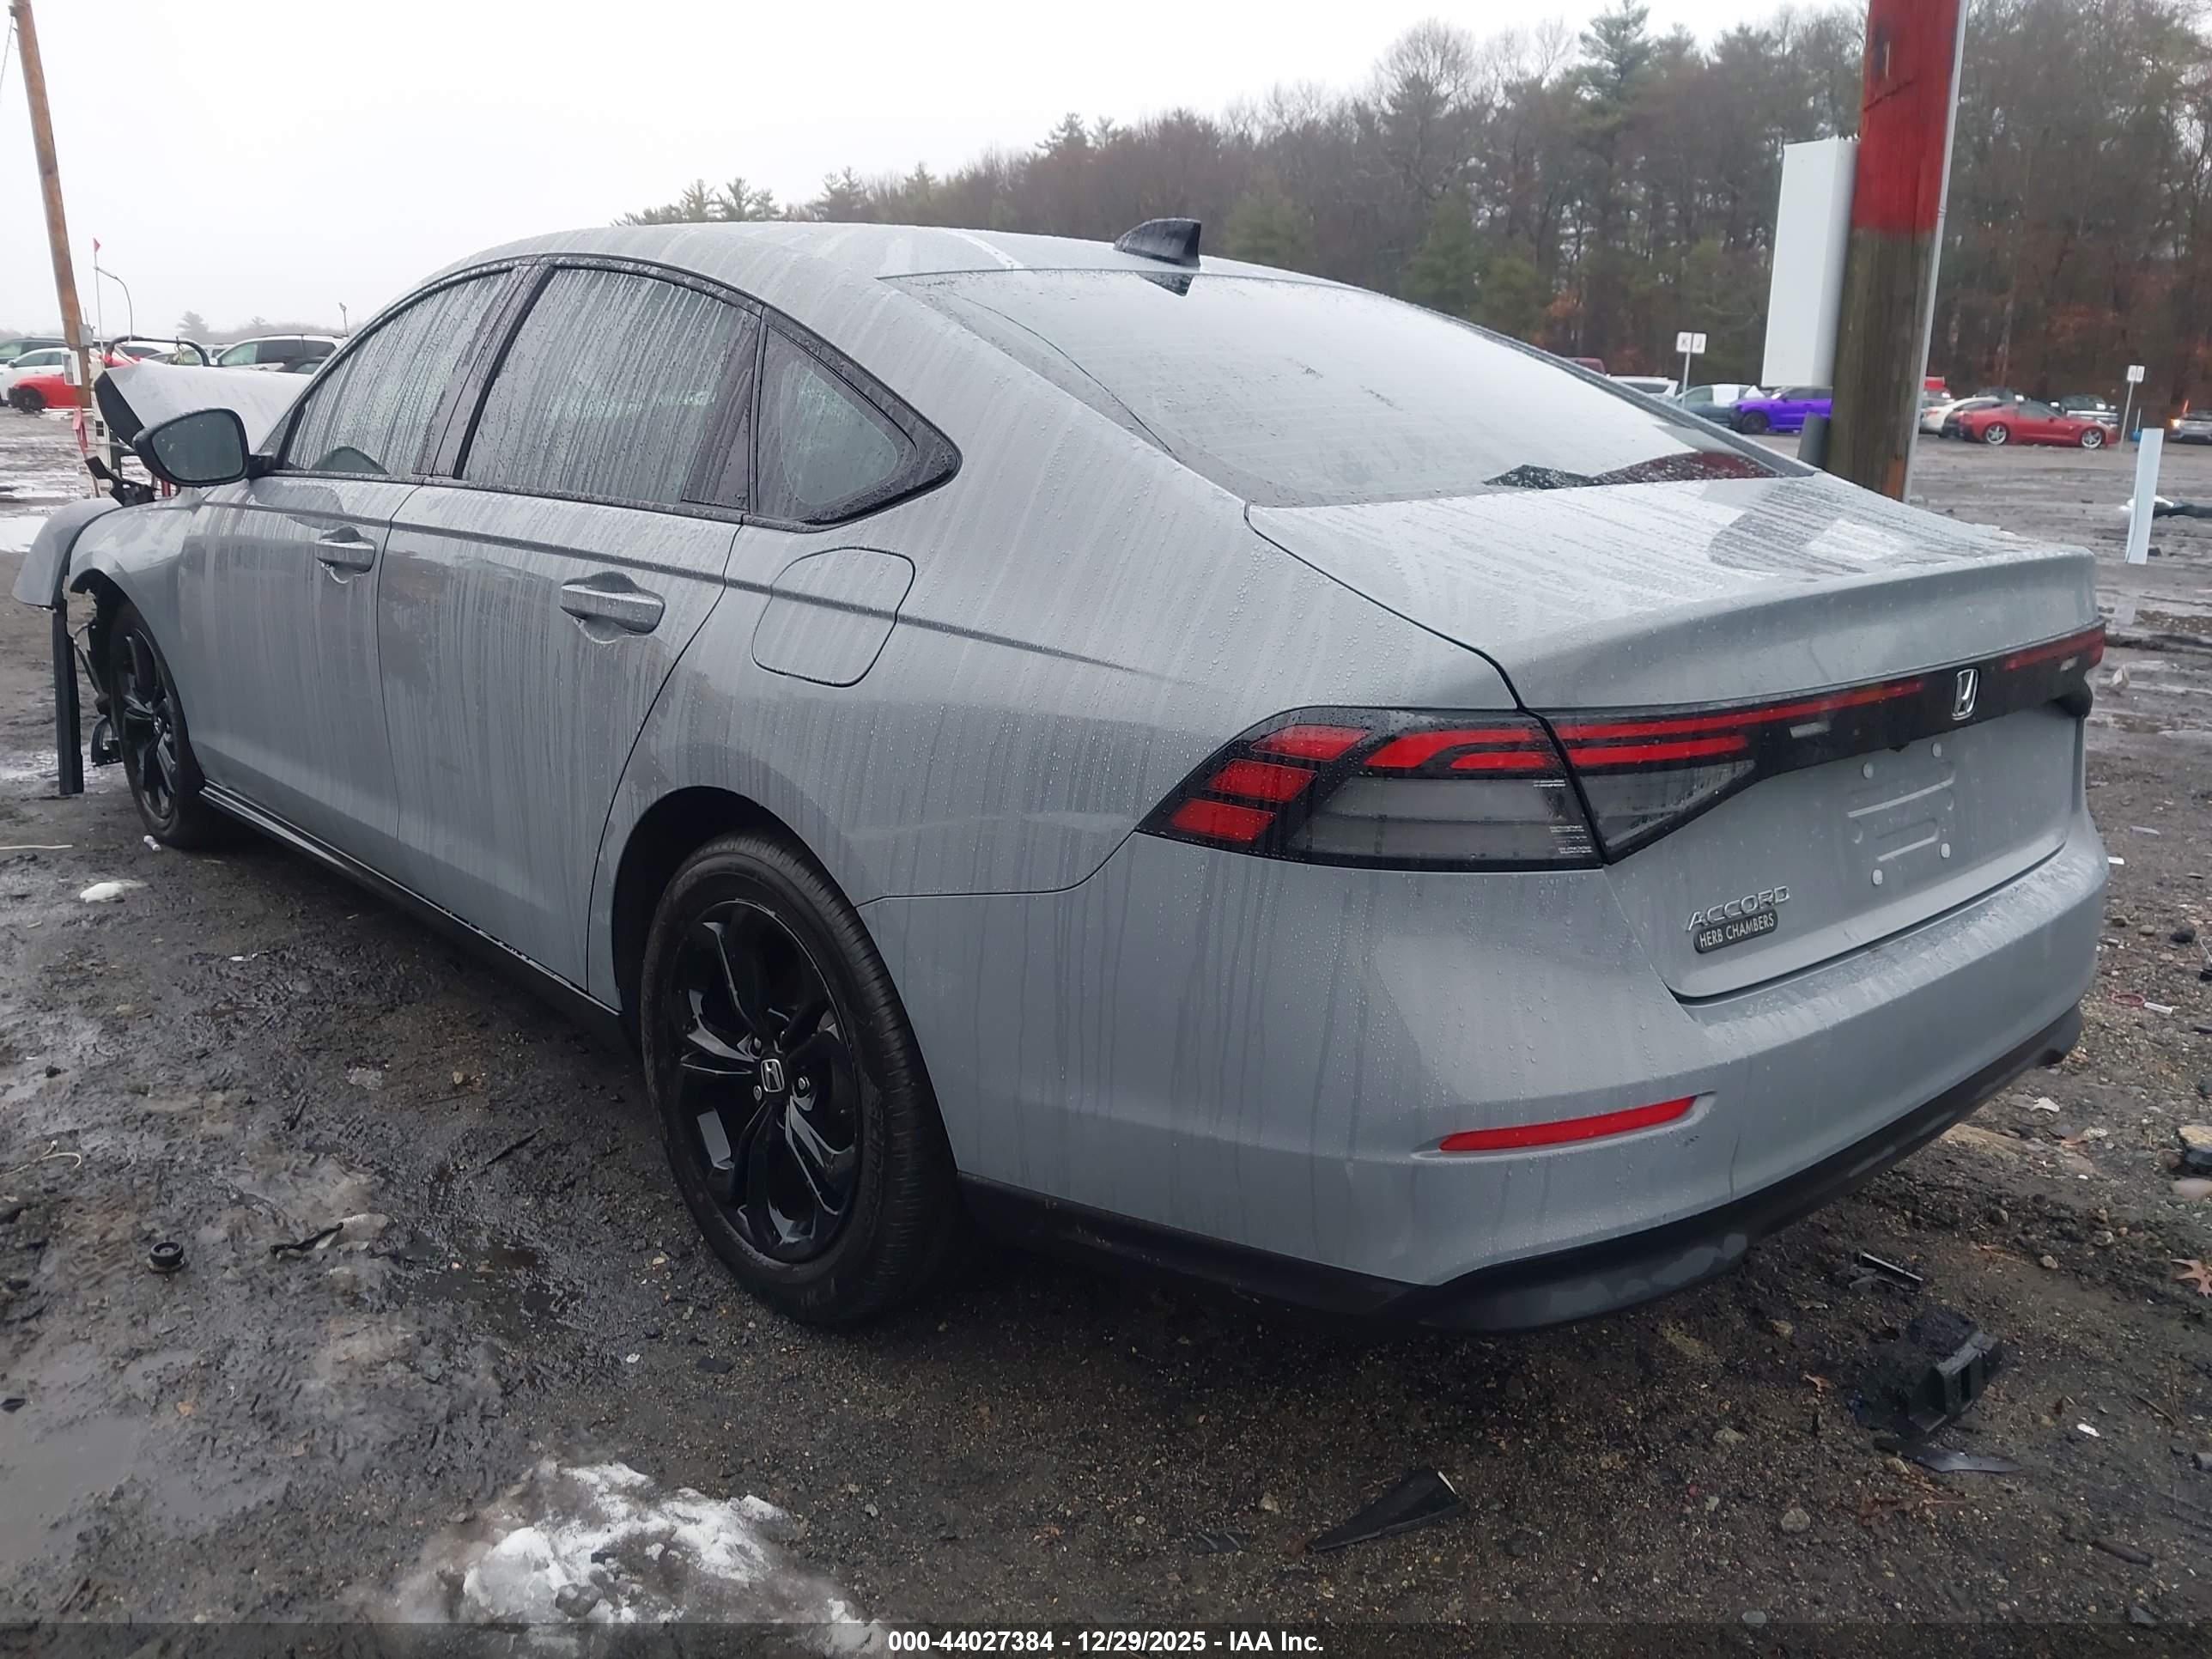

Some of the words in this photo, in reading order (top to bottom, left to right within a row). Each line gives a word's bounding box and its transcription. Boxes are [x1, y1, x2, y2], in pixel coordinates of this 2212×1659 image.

[1686, 885, 1790, 933] ACCORD
[1698, 928, 1723, 949] HERB
[1725, 912, 1775, 940] CHAMBERS
